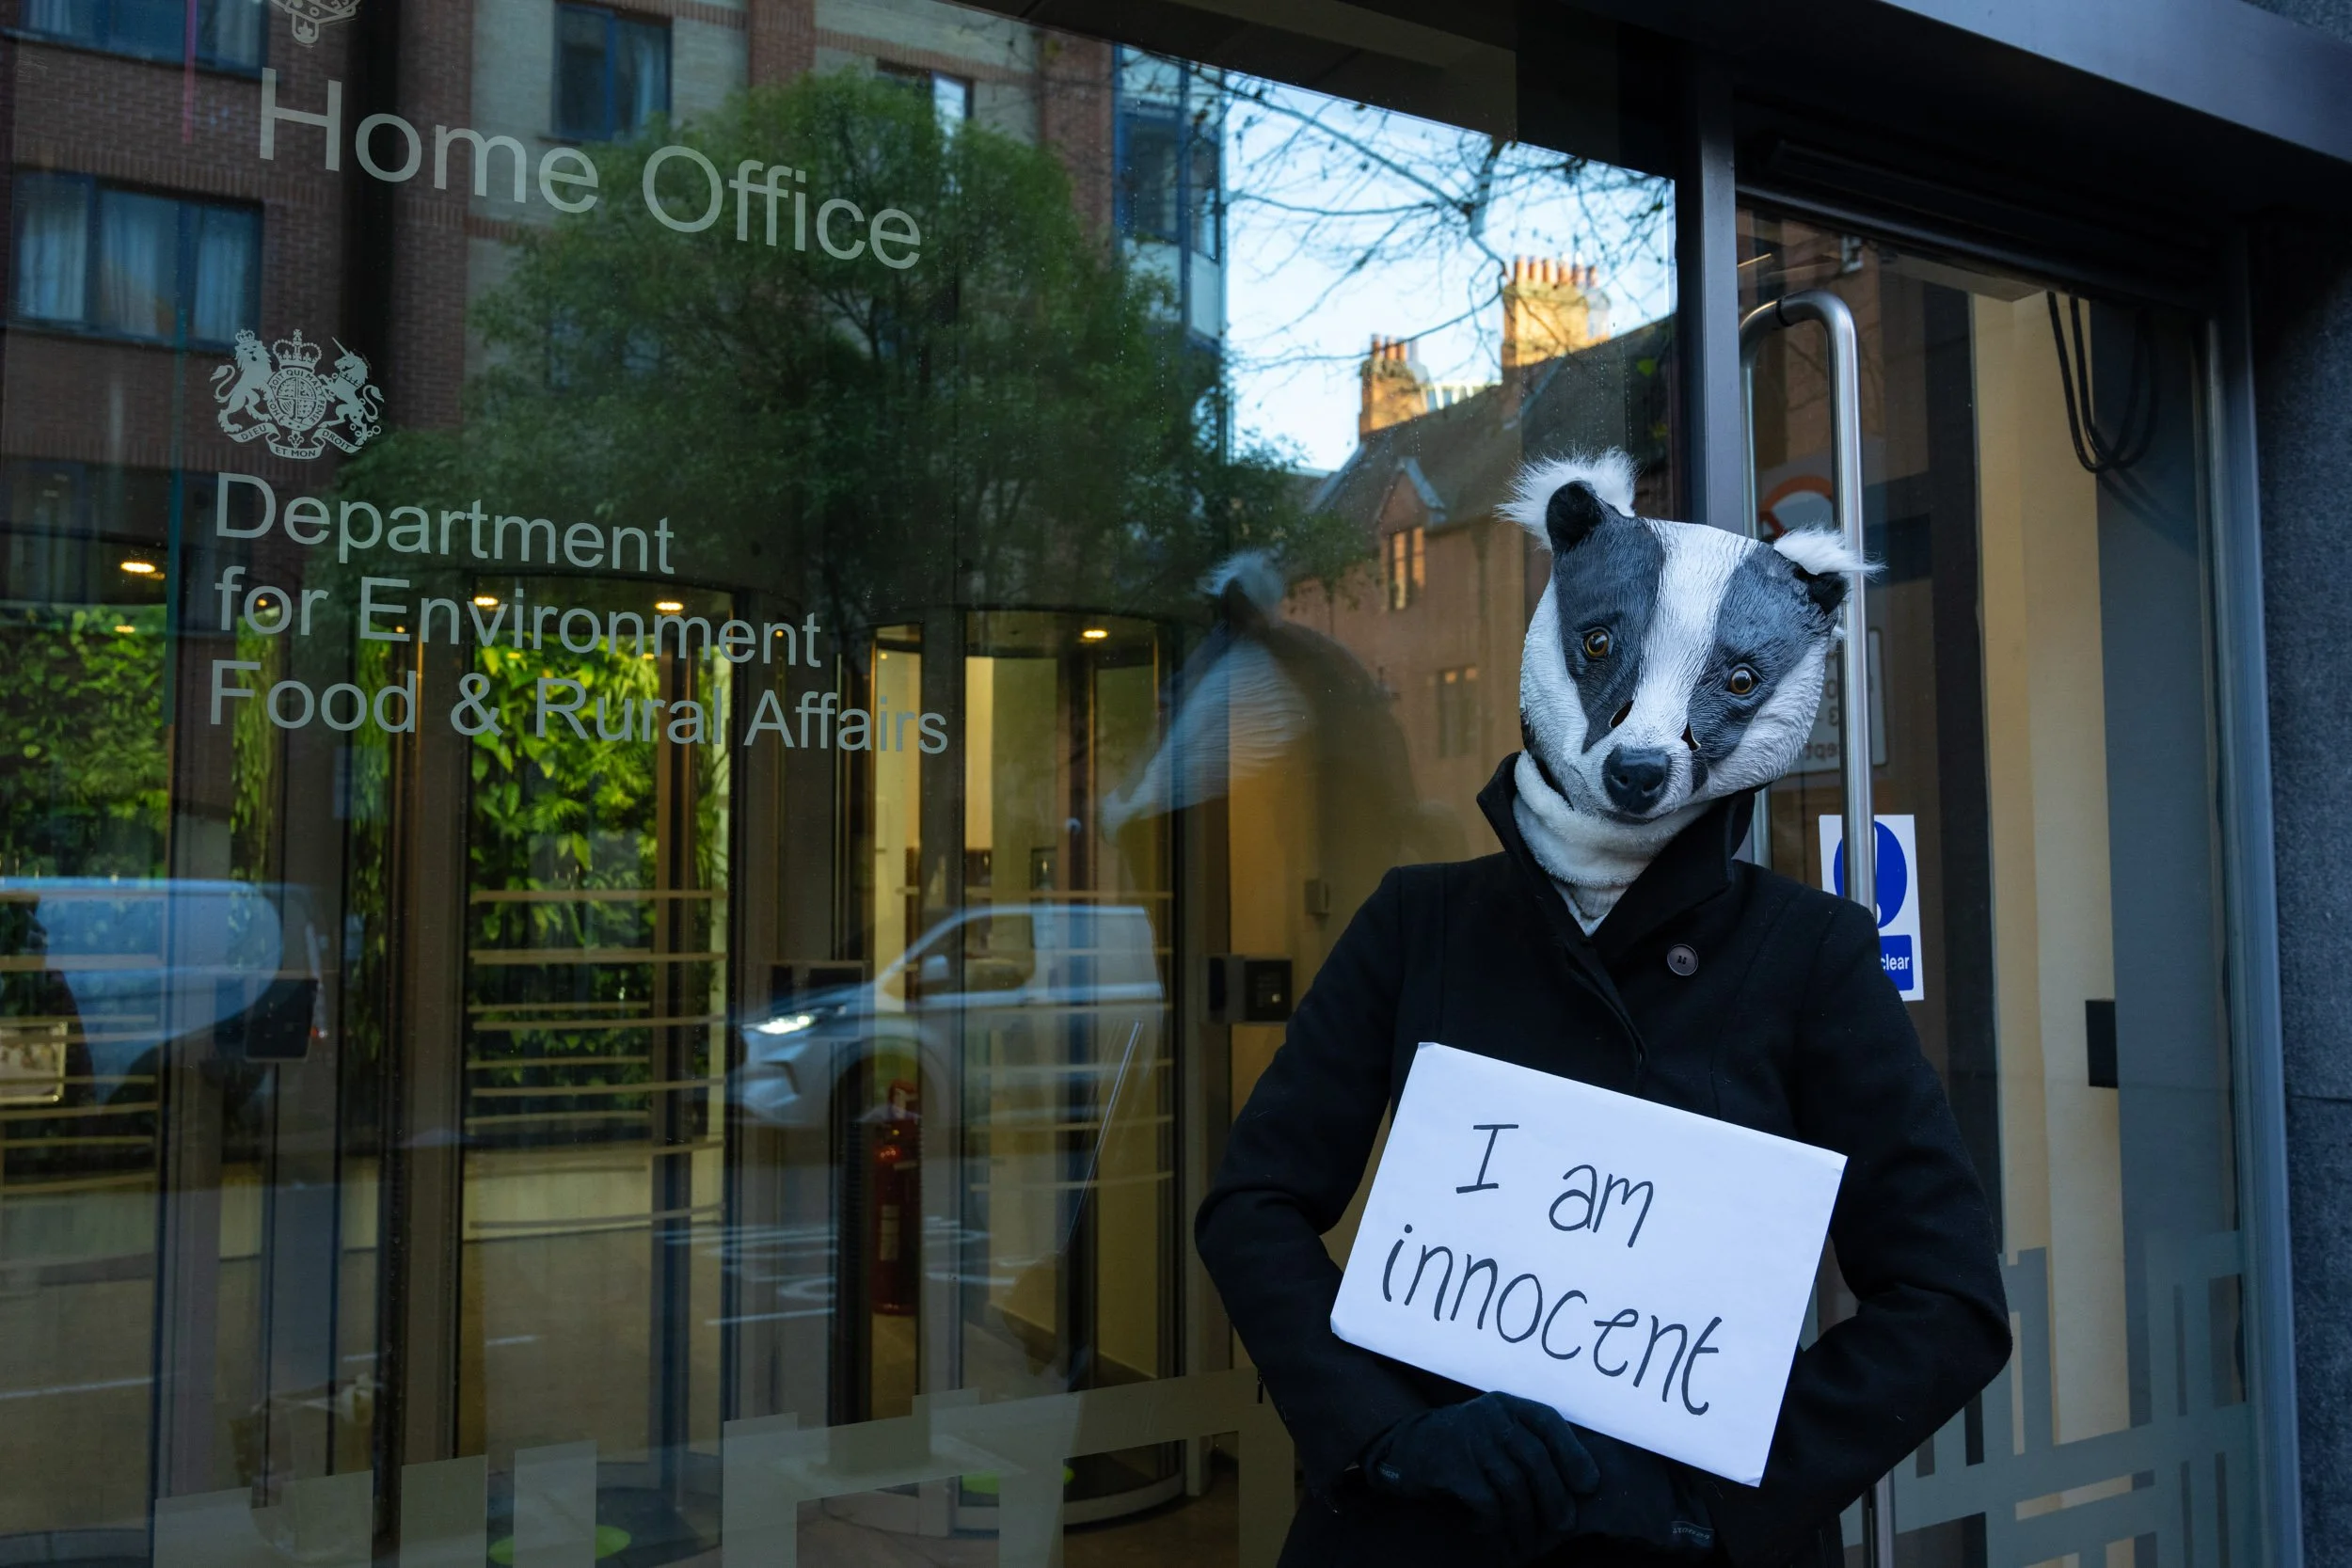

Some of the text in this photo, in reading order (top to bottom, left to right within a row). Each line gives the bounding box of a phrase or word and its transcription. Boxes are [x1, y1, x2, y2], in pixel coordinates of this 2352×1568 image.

[260, 67, 922, 270] Home Office
[240, 425, 352, 457] DIEU ET MON DROIT
[286, 369, 304, 377] QUI
[309, 400, 326, 423] PENSE
[215, 471, 675, 575] Department
[215, 565, 822, 668] for Environment
[210, 659, 948, 754] Food & Rural Affairs
[1455, 1123, 1655, 1248] I am
[1382, 1224, 1723, 1416] innocent
